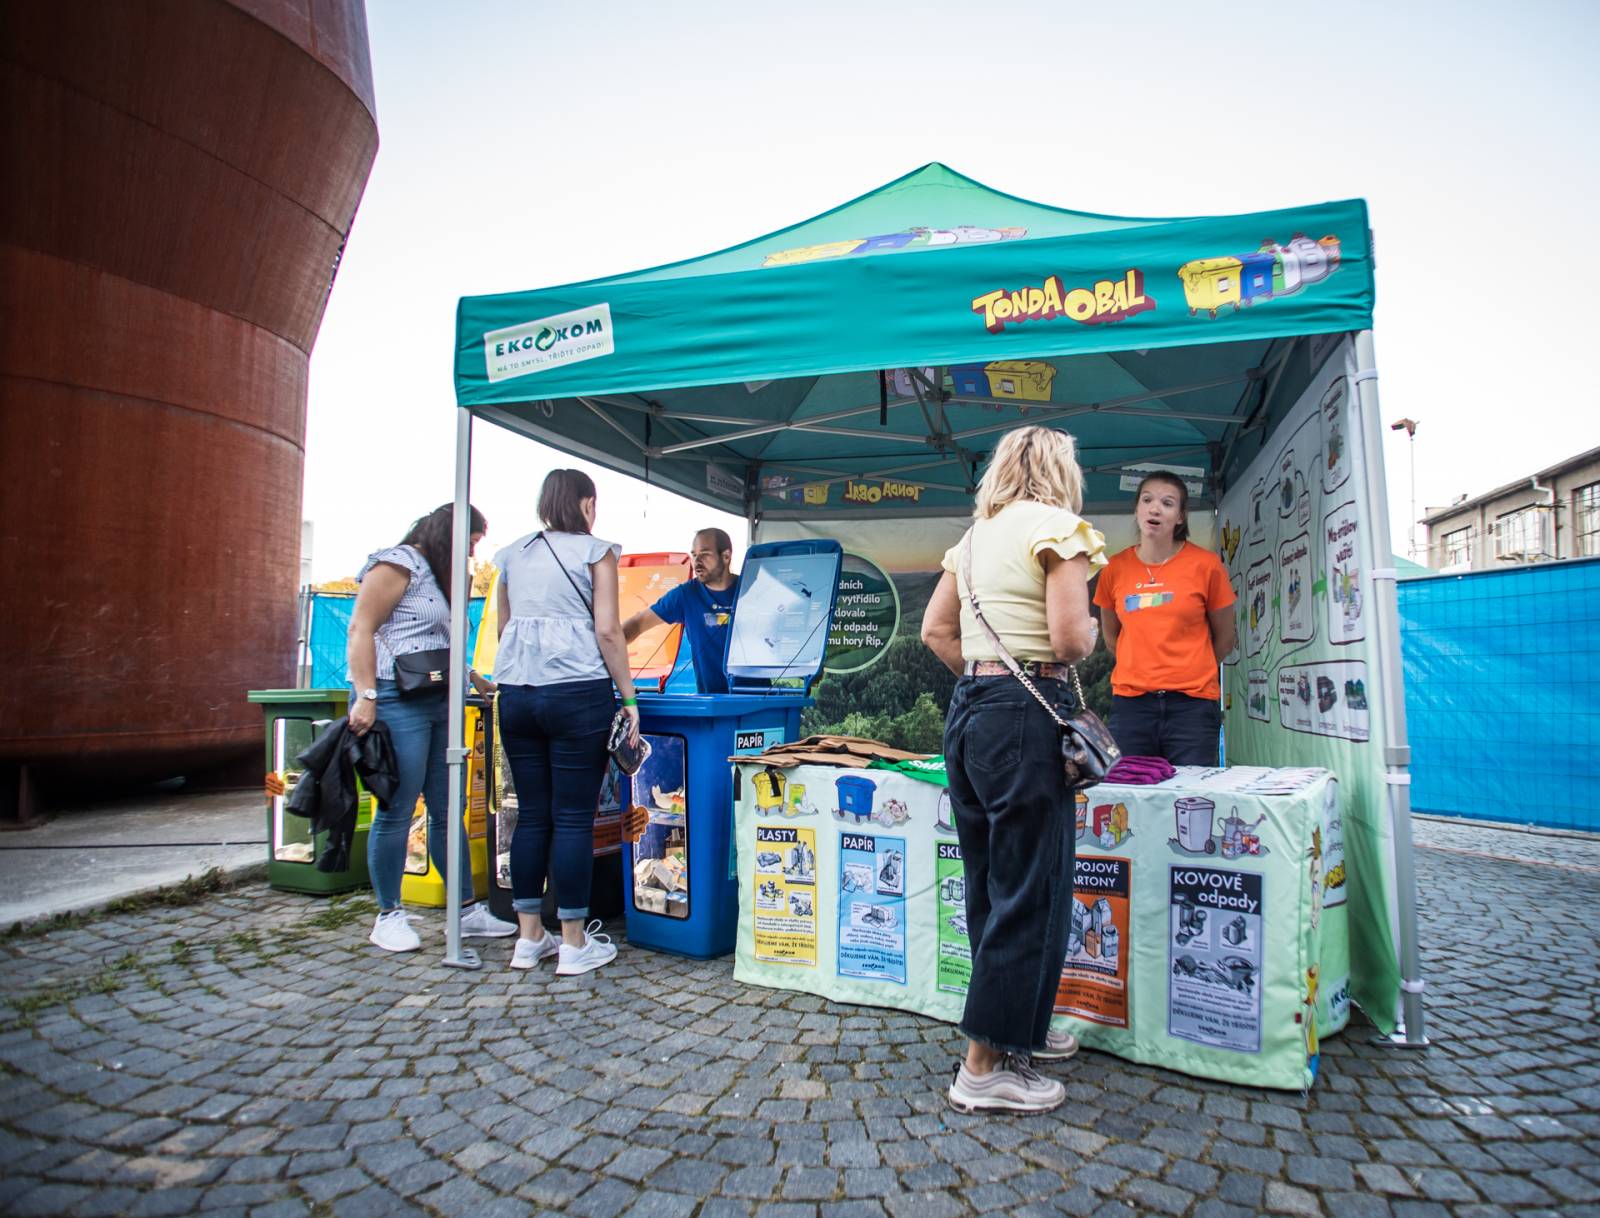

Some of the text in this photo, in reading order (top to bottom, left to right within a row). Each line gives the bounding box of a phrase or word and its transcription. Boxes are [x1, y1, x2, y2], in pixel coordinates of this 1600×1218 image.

[972, 268, 1150, 332] TONDA OBAL
[842, 593, 881, 606] vytřídilo
[843, 621, 878, 634] odpadu
[843, 634, 864, 648] hory
[865, 633, 884, 648] Říp.
[737, 732, 764, 749] PAPÍR
[757, 828, 797, 842] PLASTY
[843, 836, 874, 852] PAPÍR
[939, 845, 962, 859] SKL
[1074, 861, 1120, 874] POJOVÉ
[1073, 875, 1116, 888] ARTONY
[1173, 871, 1243, 892] KOVOVÉ
[1198, 888, 1259, 914] odpady
